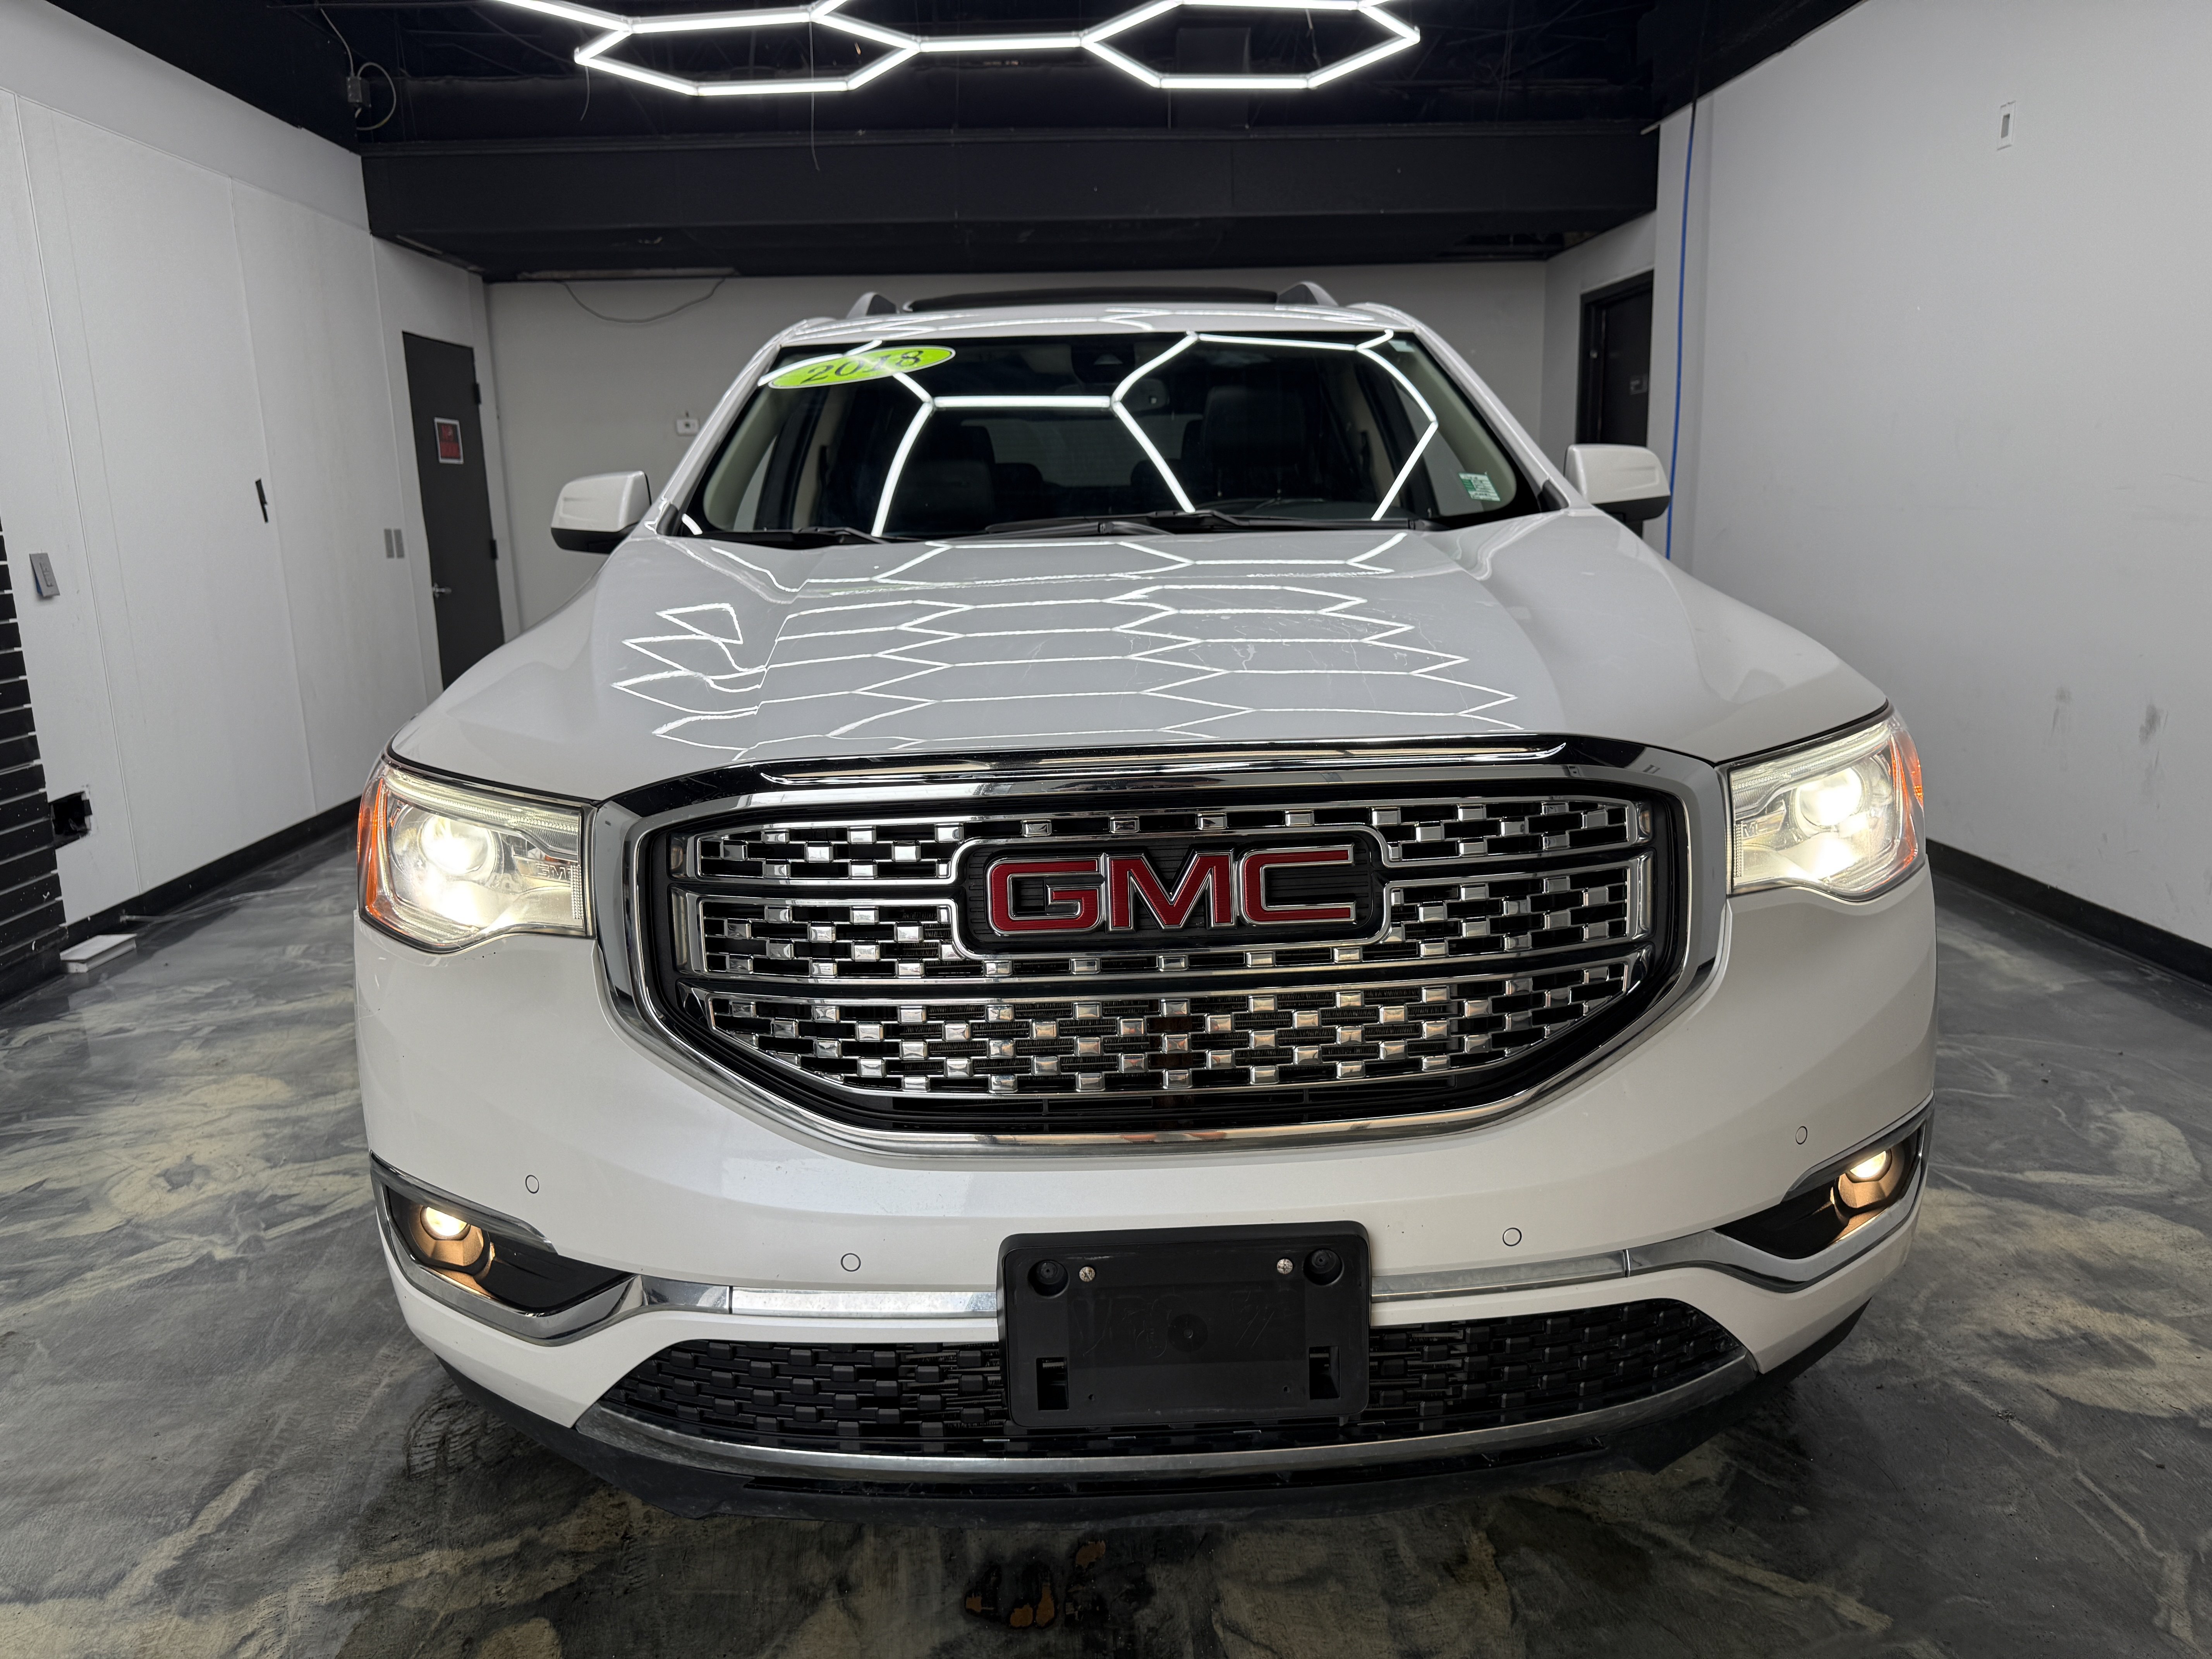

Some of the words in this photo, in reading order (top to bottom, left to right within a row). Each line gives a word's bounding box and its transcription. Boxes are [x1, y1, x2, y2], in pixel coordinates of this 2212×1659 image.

[800, 350, 924, 385] 2018
[1741, 820, 1768, 838] MC
[986, 843, 1356, 936] GMC
